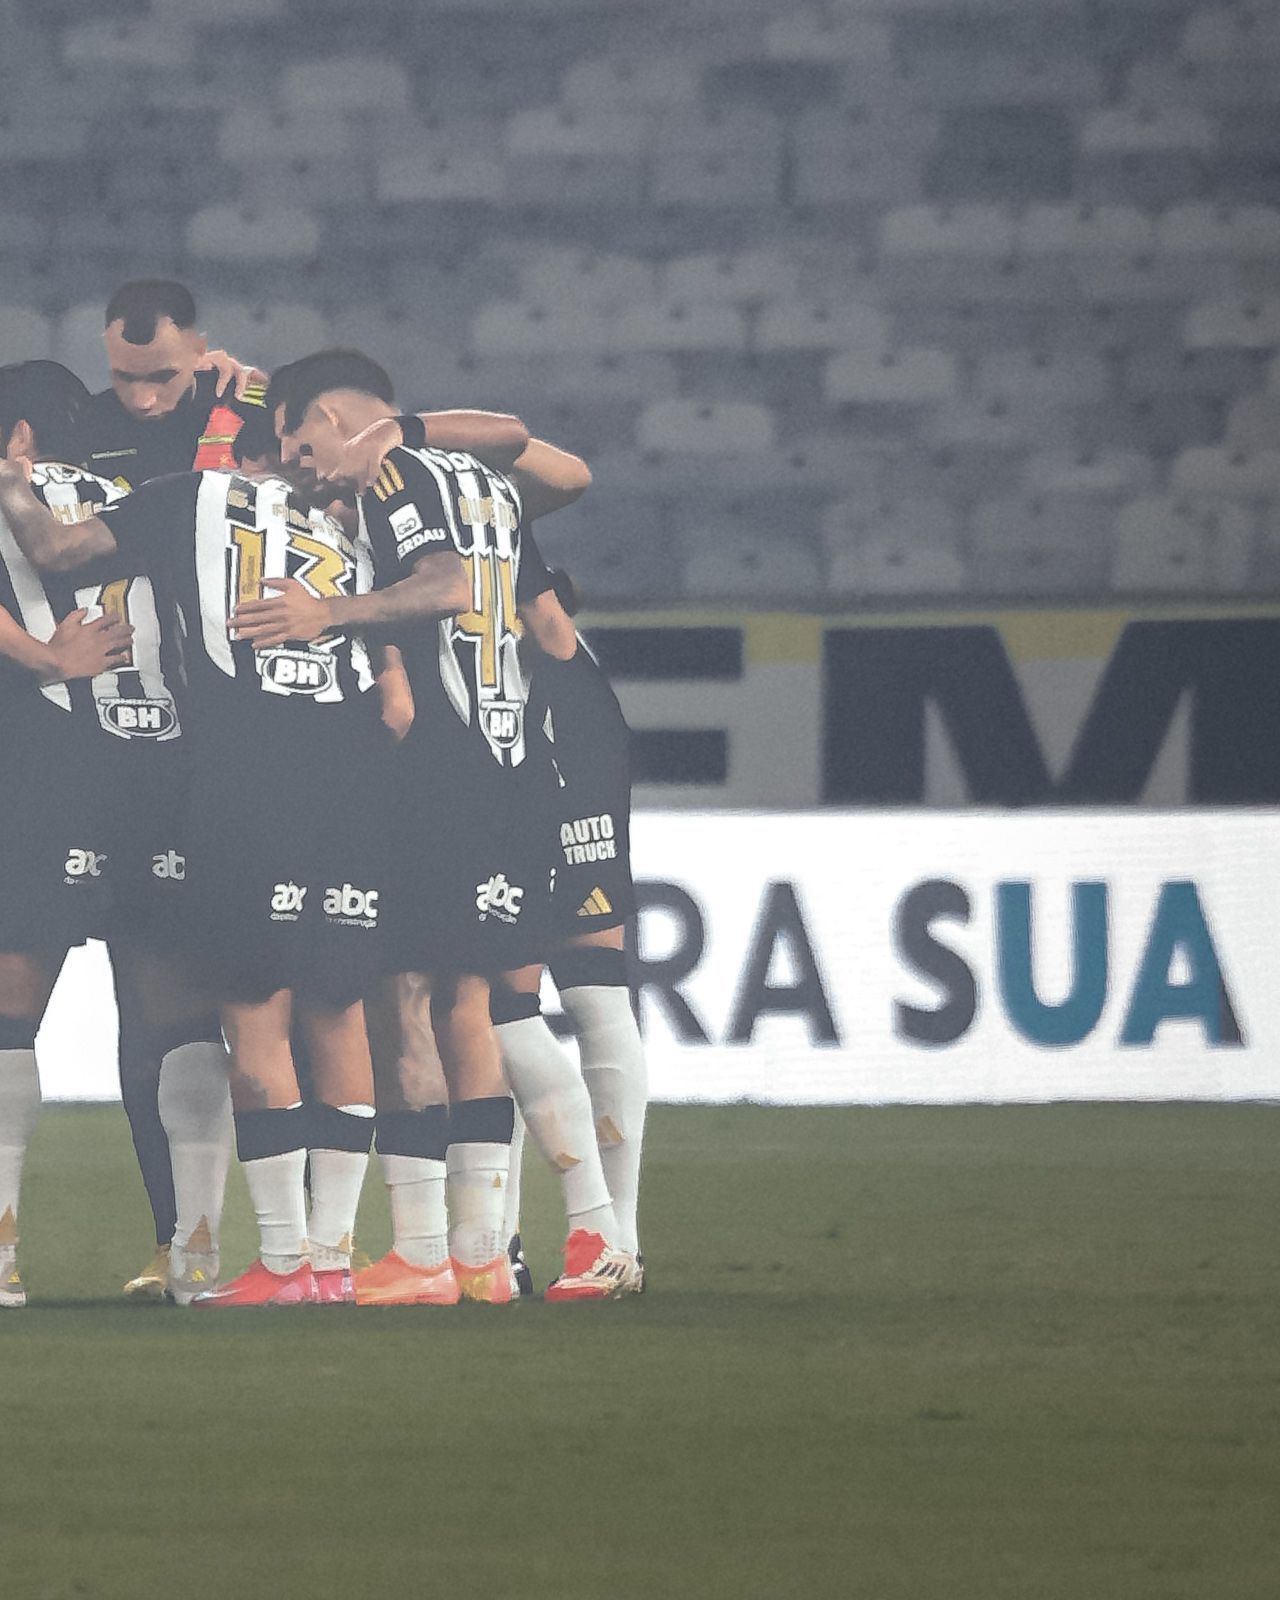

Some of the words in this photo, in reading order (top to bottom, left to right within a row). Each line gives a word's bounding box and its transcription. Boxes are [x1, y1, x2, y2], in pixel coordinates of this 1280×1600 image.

[396, 527, 447, 560] ERDAU
[274, 658, 321, 686] BH
[116, 705, 162, 730] BH
[488, 709, 516, 739] BH
[560, 813, 615, 847] AUTO
[563, 838, 618, 866] TRUCK
[323, 883, 379, 919] abc
[891, 876, 1249, 1050] SUA
